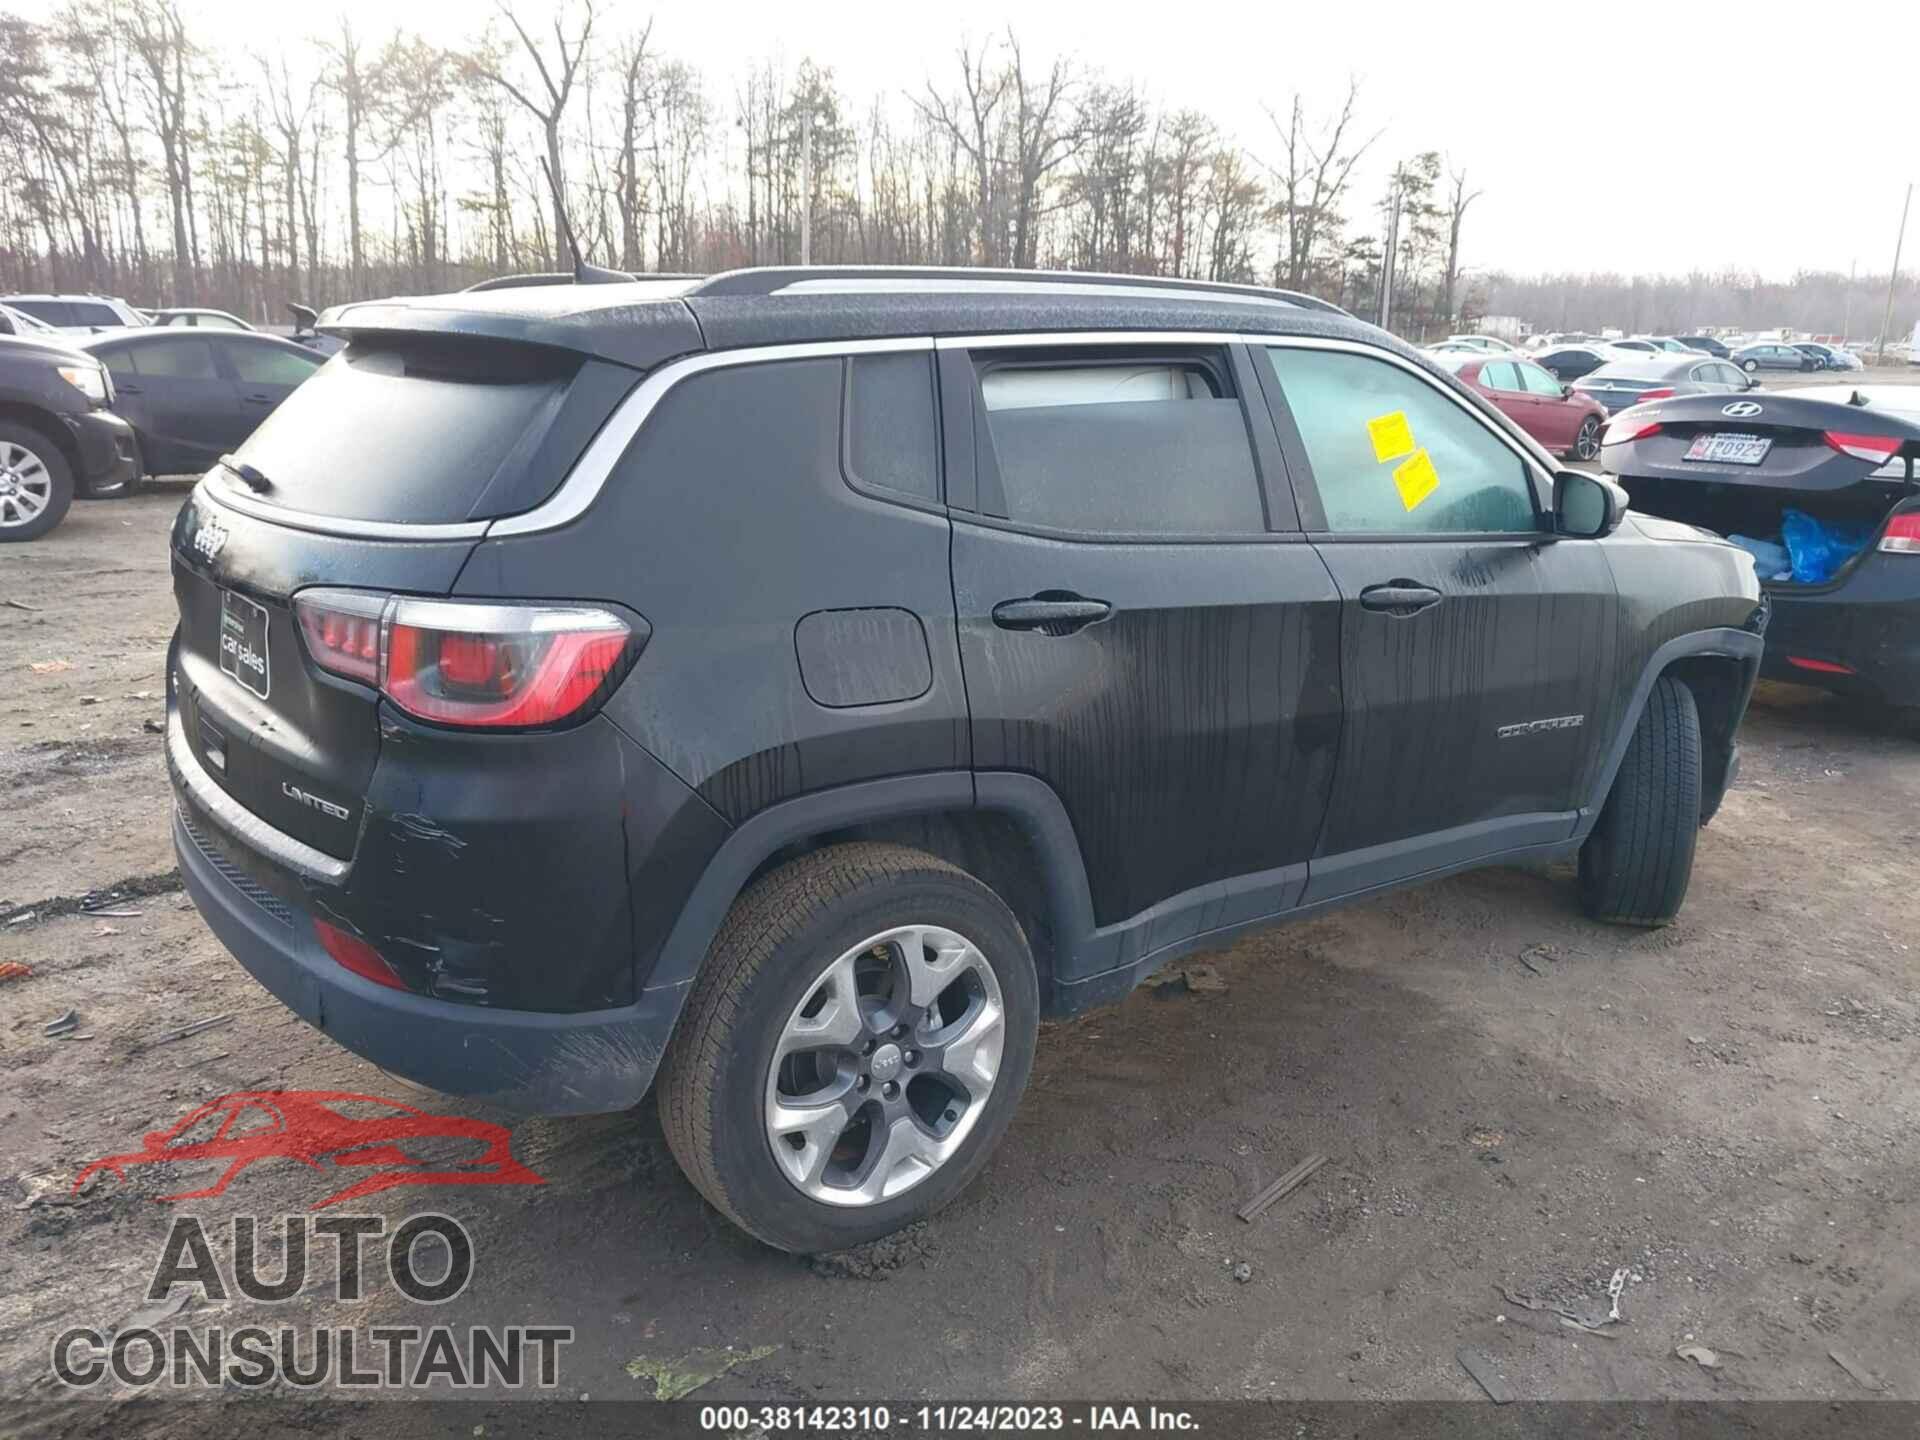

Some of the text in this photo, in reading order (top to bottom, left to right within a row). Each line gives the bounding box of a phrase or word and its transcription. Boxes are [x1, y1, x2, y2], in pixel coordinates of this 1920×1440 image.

[222, 633, 265, 675] car sales
[281, 781, 350, 821] LIMITED
